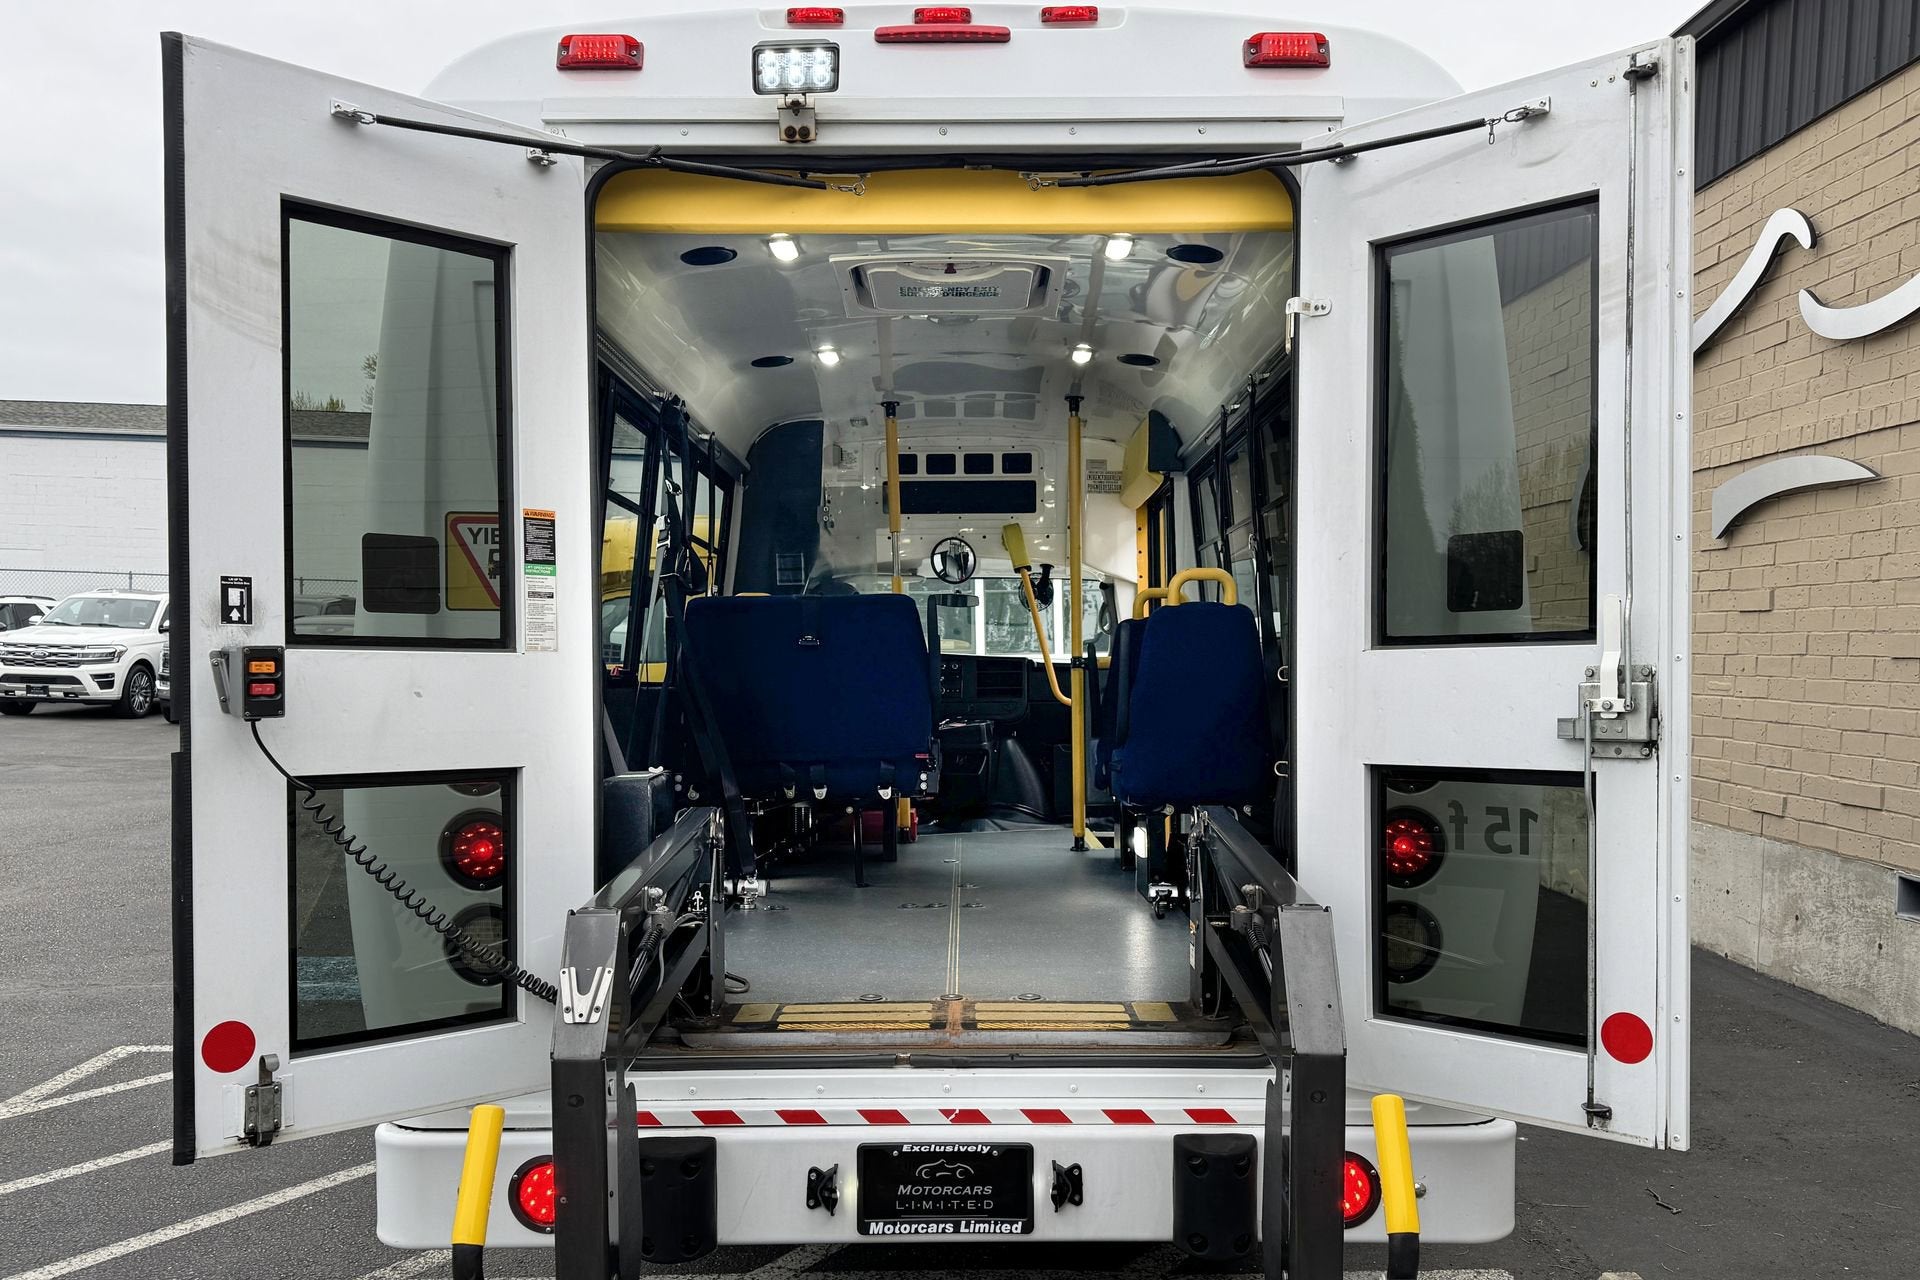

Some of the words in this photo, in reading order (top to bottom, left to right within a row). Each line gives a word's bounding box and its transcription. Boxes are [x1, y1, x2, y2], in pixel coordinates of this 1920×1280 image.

[902, 1144, 991, 1154] Exclusively
[897, 1184, 993, 1196] MOTORCARS
[869, 1221, 954, 1235] Motorcars
[960, 1220, 1022, 1234] Limited
